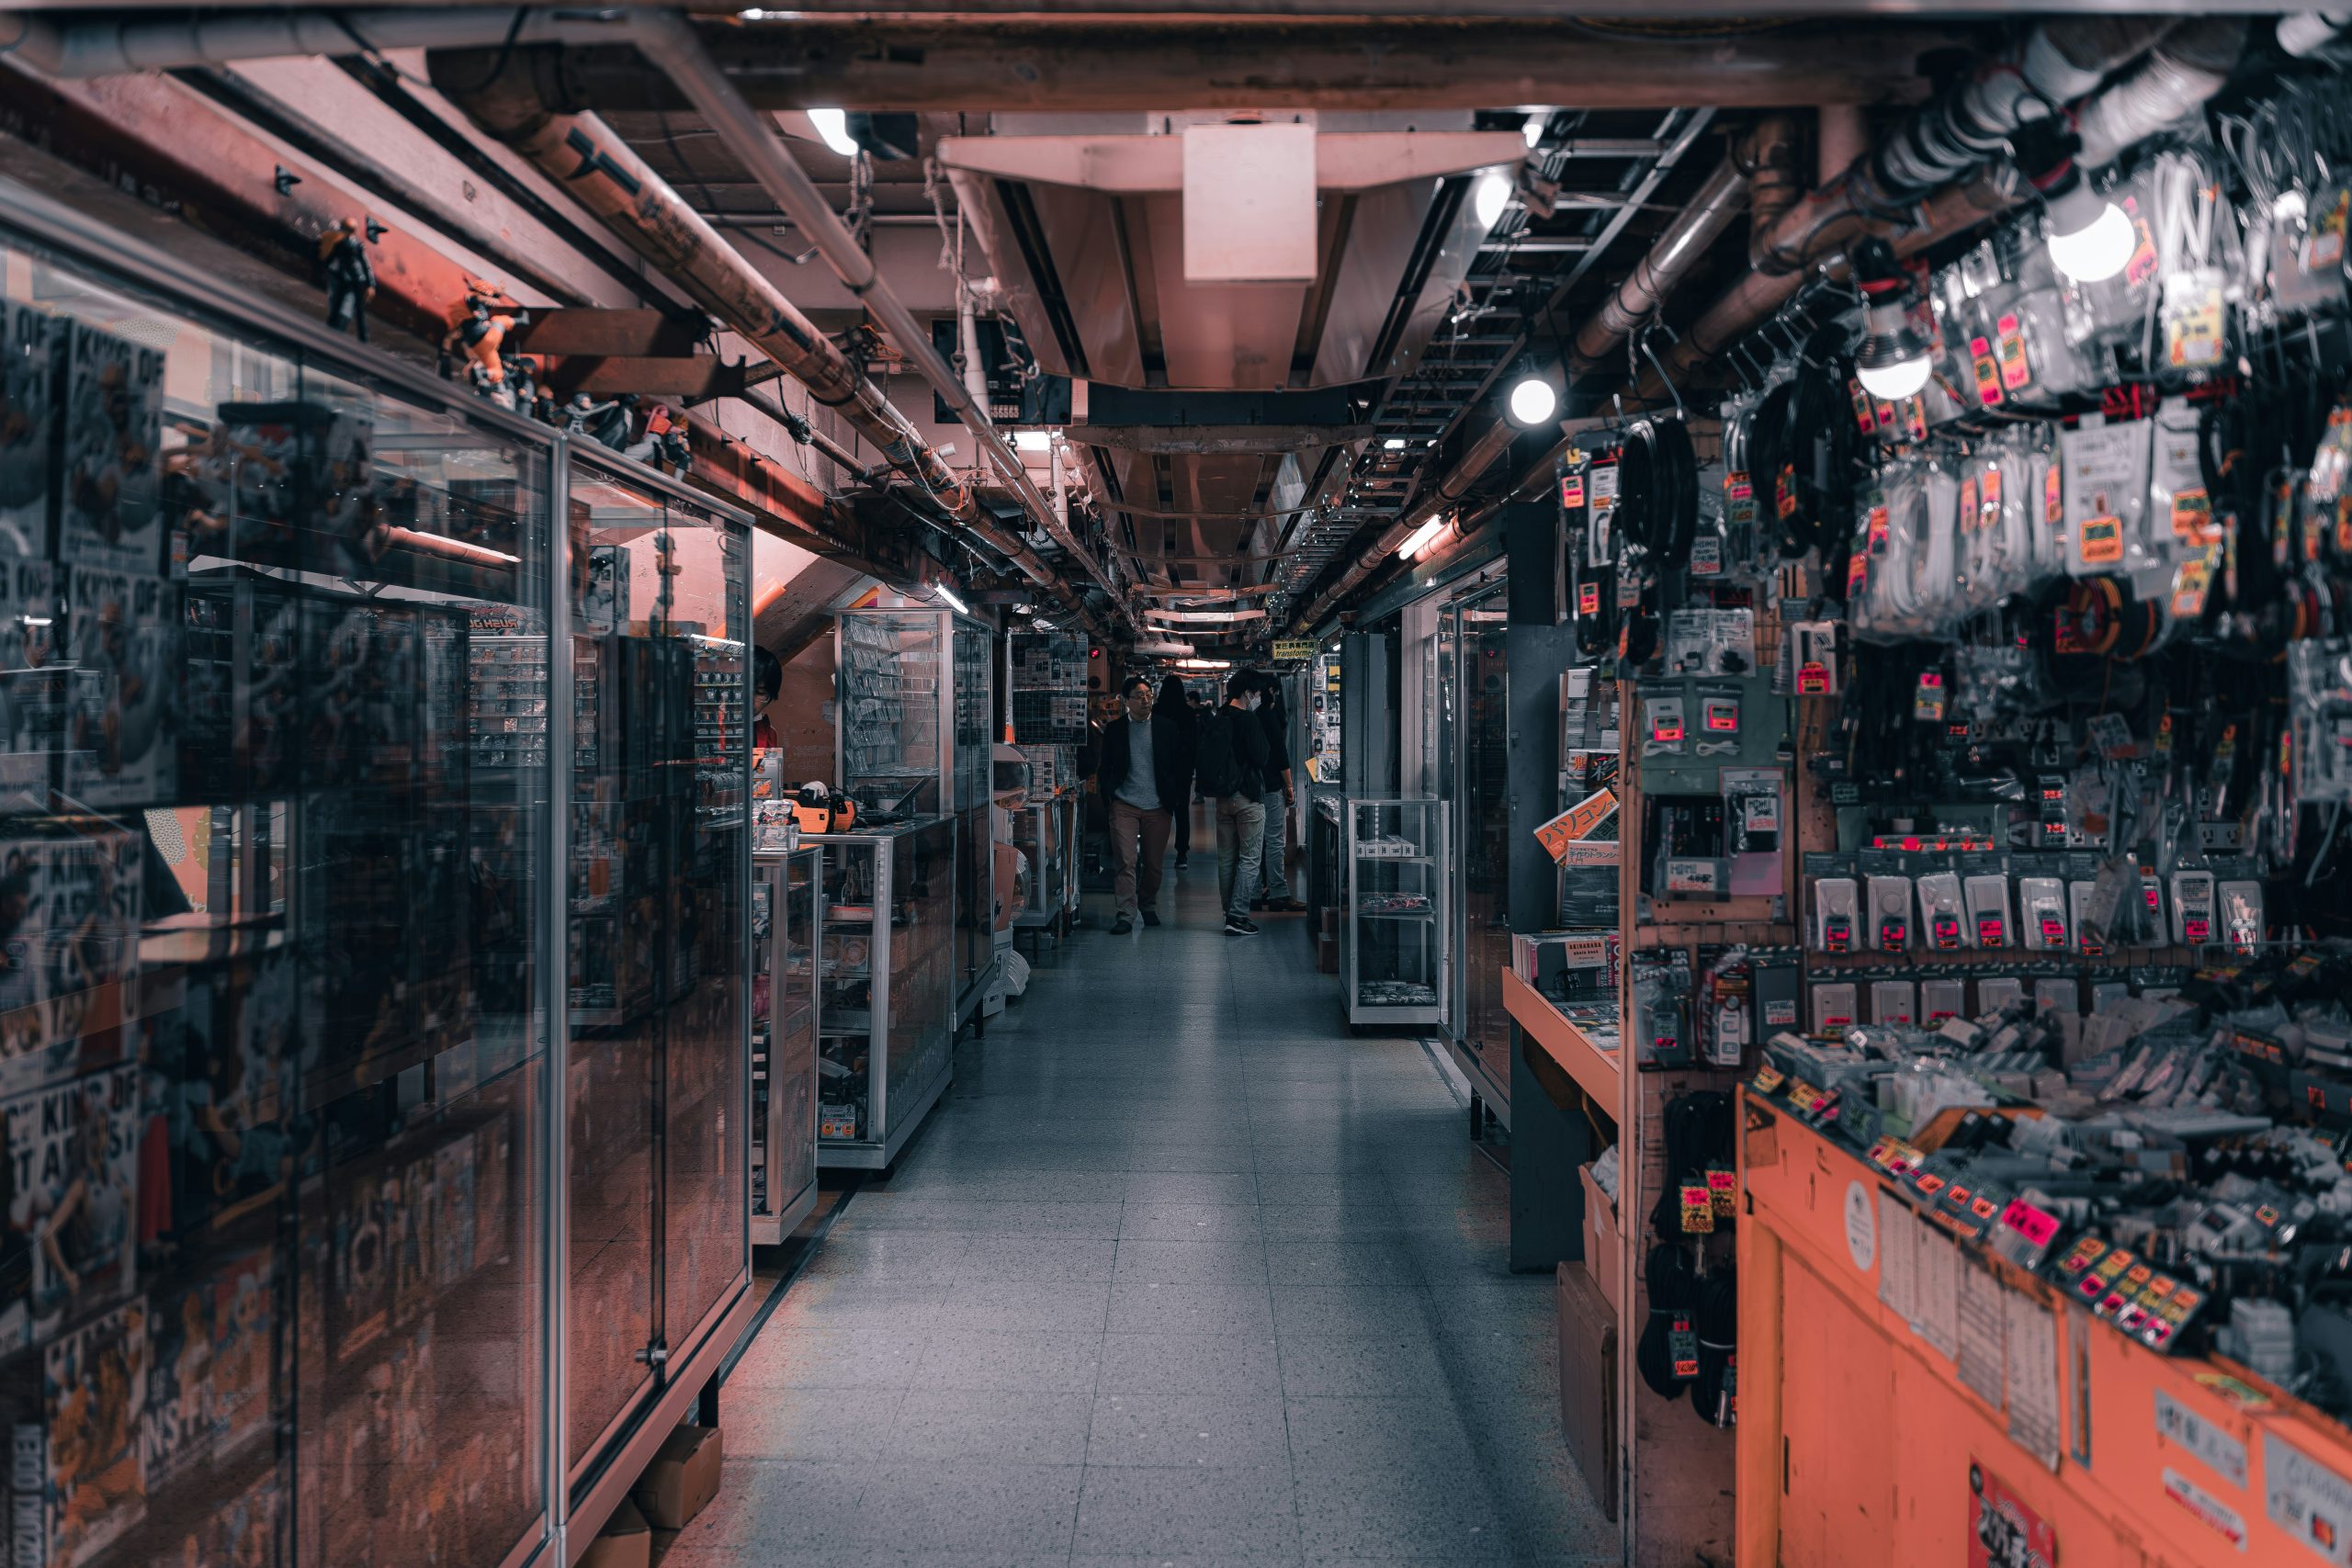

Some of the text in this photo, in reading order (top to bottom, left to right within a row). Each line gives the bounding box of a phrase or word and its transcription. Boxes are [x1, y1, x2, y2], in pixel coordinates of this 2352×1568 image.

[1568, 852, 1618, 860] 手作りトランシ
